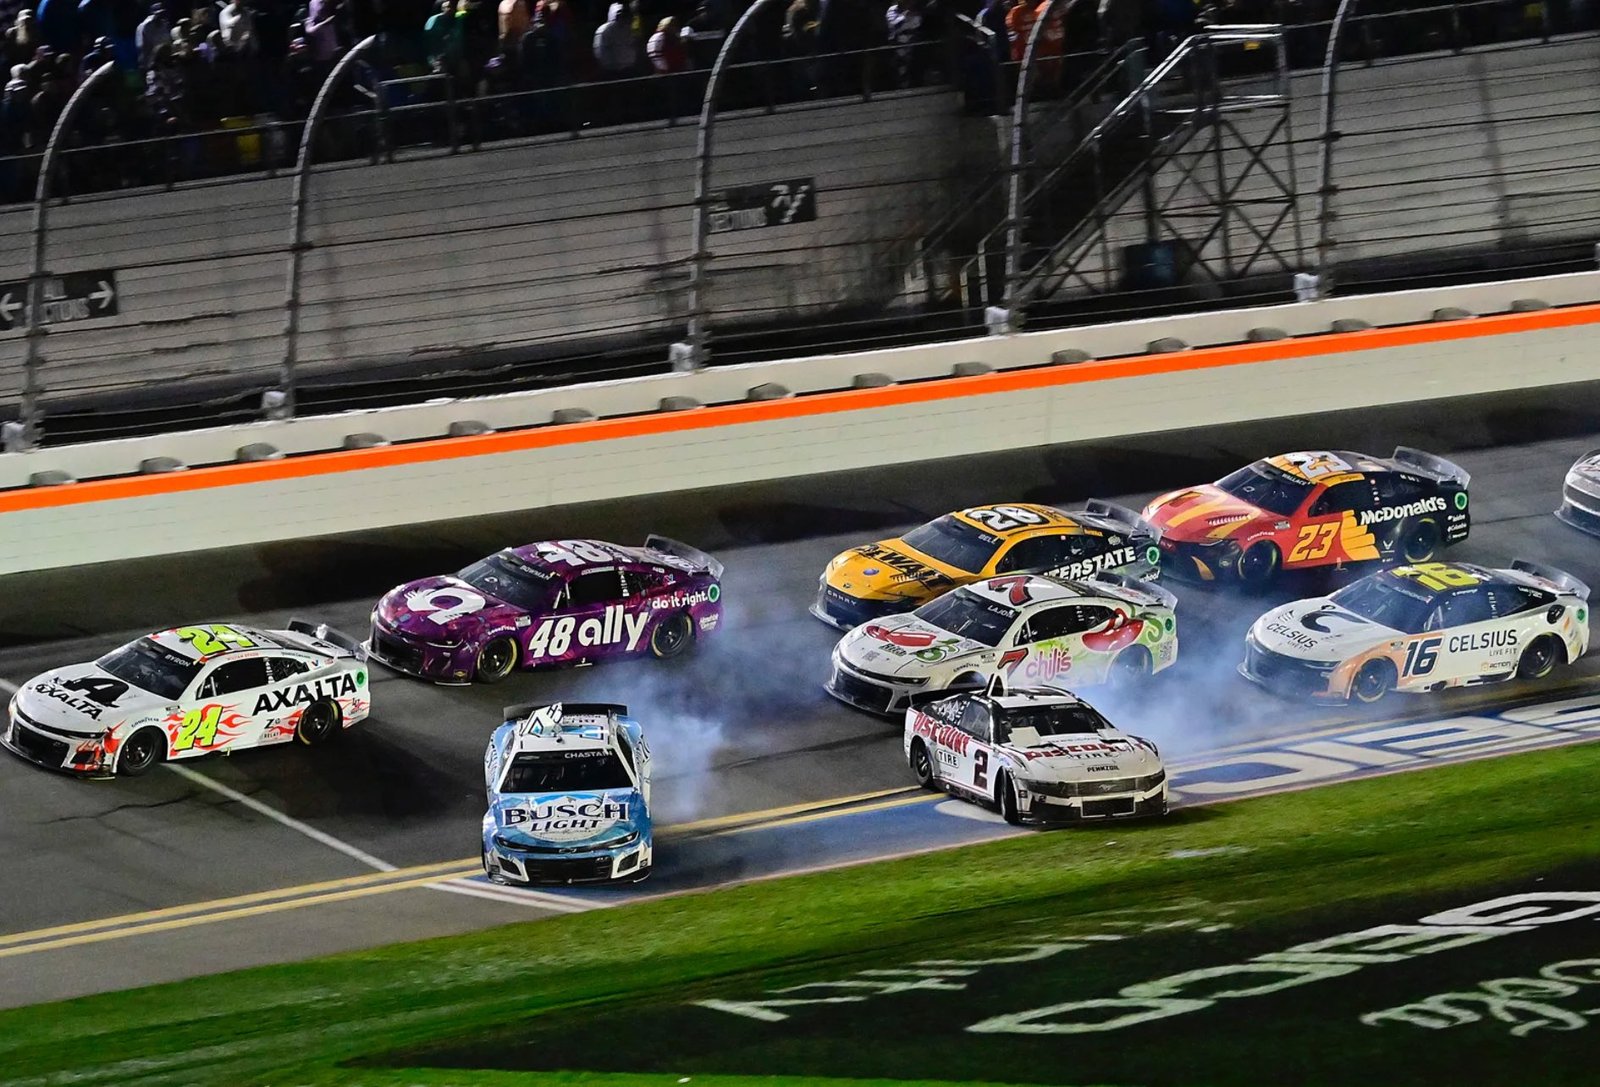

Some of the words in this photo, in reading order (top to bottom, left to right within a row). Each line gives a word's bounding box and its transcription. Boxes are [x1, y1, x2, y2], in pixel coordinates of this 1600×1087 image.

[1282, 473, 1307, 487] WALLACE
[1360, 496, 1447, 525] McDonald's
[978, 534, 998, 545] BELL
[1286, 521, 1341, 562] 23
[1044, 546, 1136, 580] TERSTATE
[652, 597, 669, 609] do
[988, 576, 1034, 606] 7
[175, 623, 259, 656] 24
[528, 616, 576, 658] 48
[578, 604, 648, 651] ally
[1267, 622, 1318, 648] CELSIUS
[1449, 629, 1518, 653] CELSIUS
[165, 654, 191, 667] BYRON
[997, 648, 1029, 678] 7
[1401, 637, 1444, 678] 16
[252, 673, 358, 716] AXALTA
[173, 705, 224, 751] 24
[913, 711, 971, 758] DISCOUNT
[938, 751, 957, 766] TIRE
[973, 749, 989, 789] 2
[1087, 765, 1119, 773] PENNZOIL
[502, 802, 629, 828] BUSCH
[531, 820, 602, 832] LIGHT
